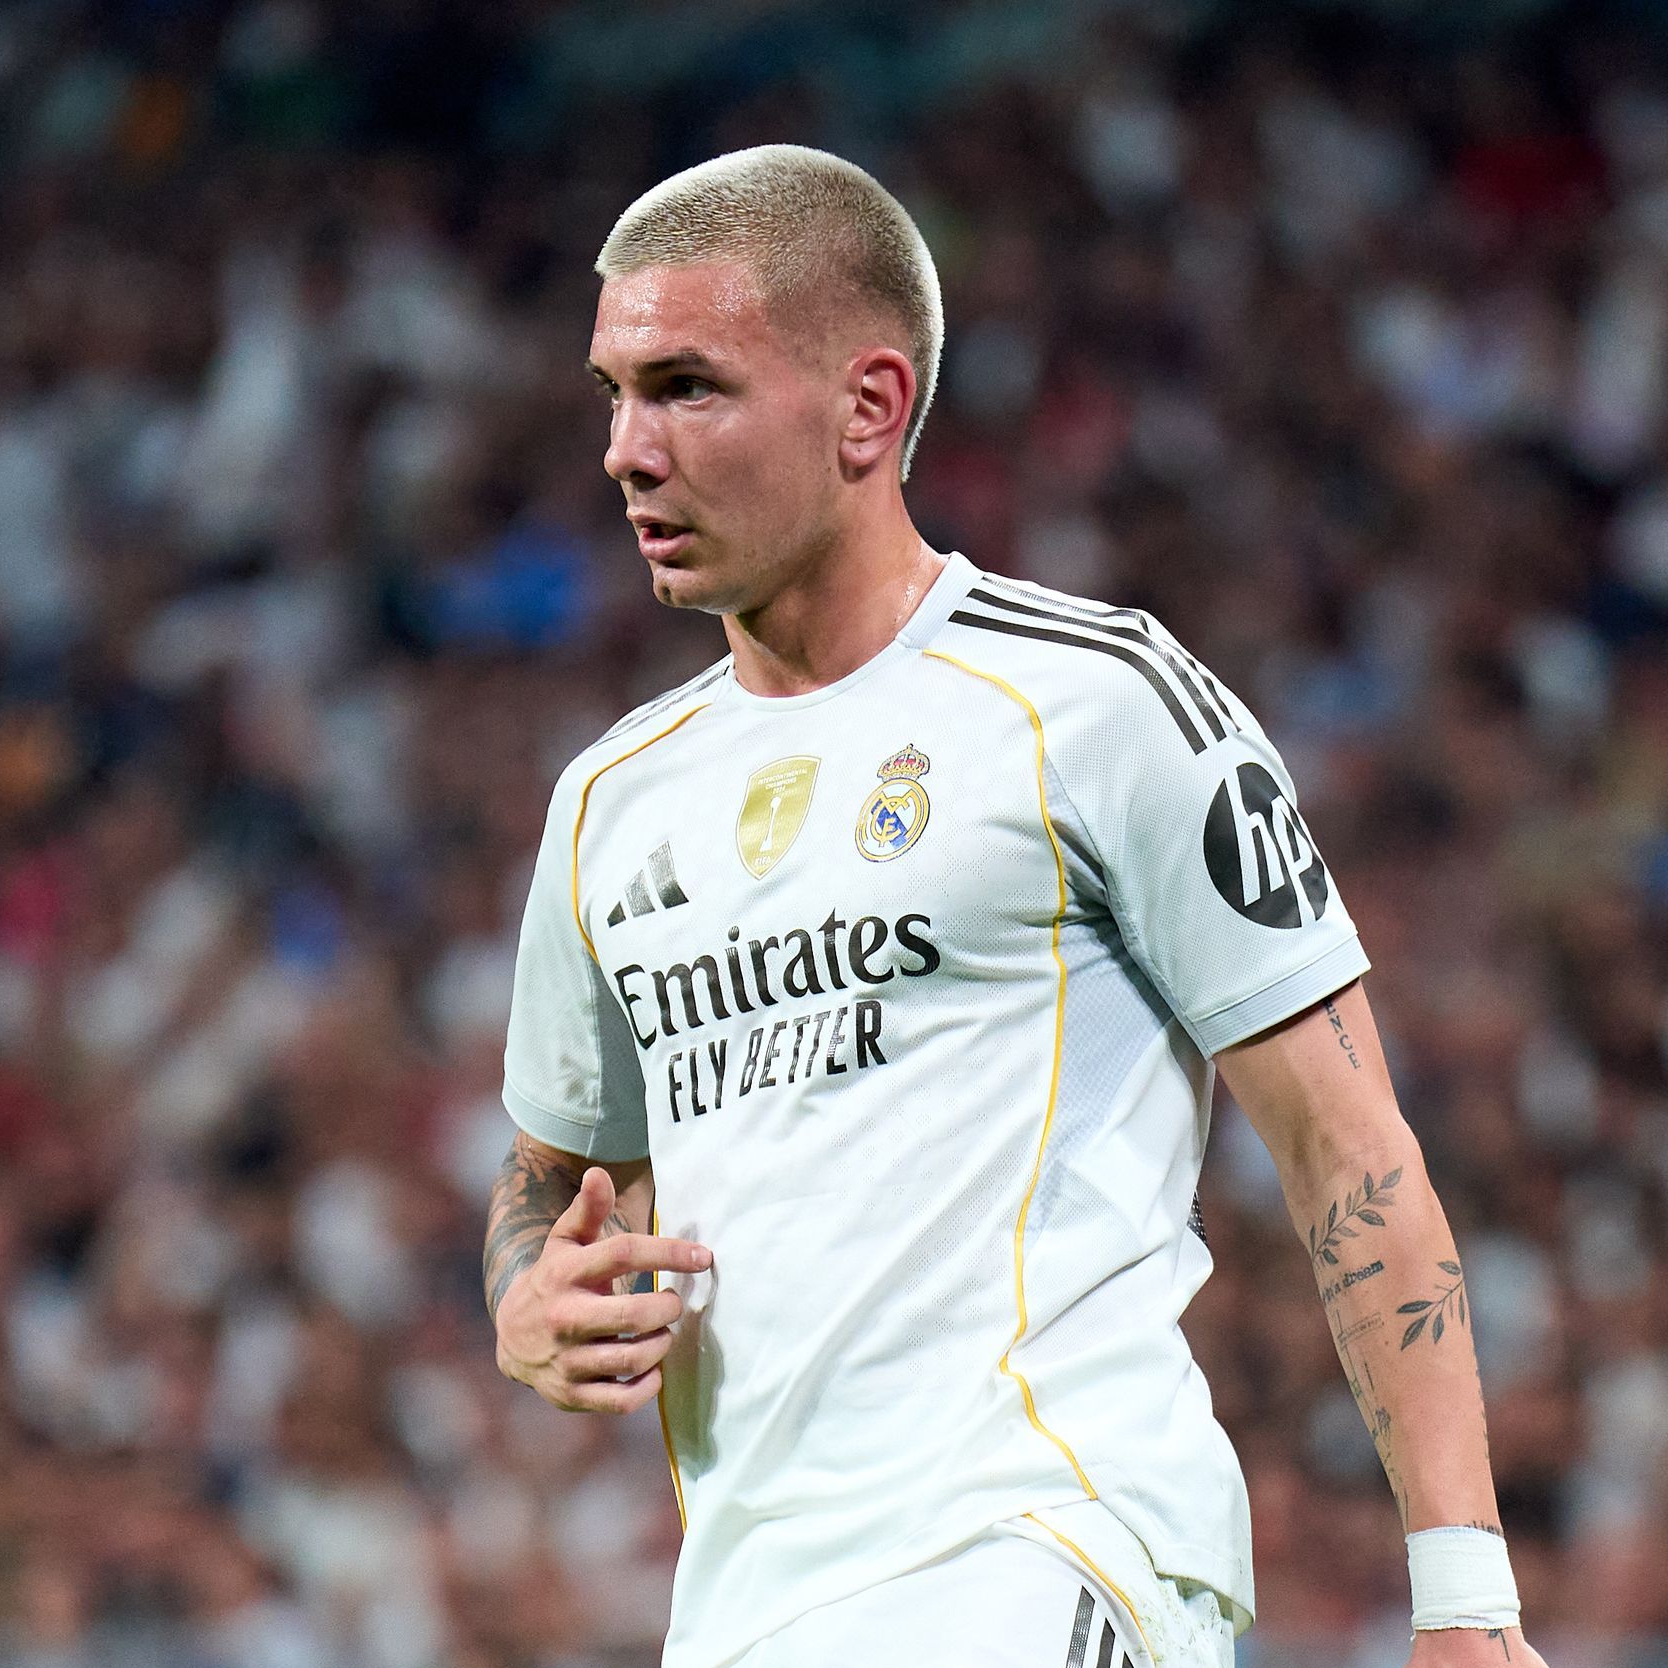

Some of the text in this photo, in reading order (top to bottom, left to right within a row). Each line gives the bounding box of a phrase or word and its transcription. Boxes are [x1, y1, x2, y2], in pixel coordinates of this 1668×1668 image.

[1221, 765, 1316, 928] hp
[613, 907, 941, 1050] Emirates
[668, 999, 888, 1123] FLY BETTER
